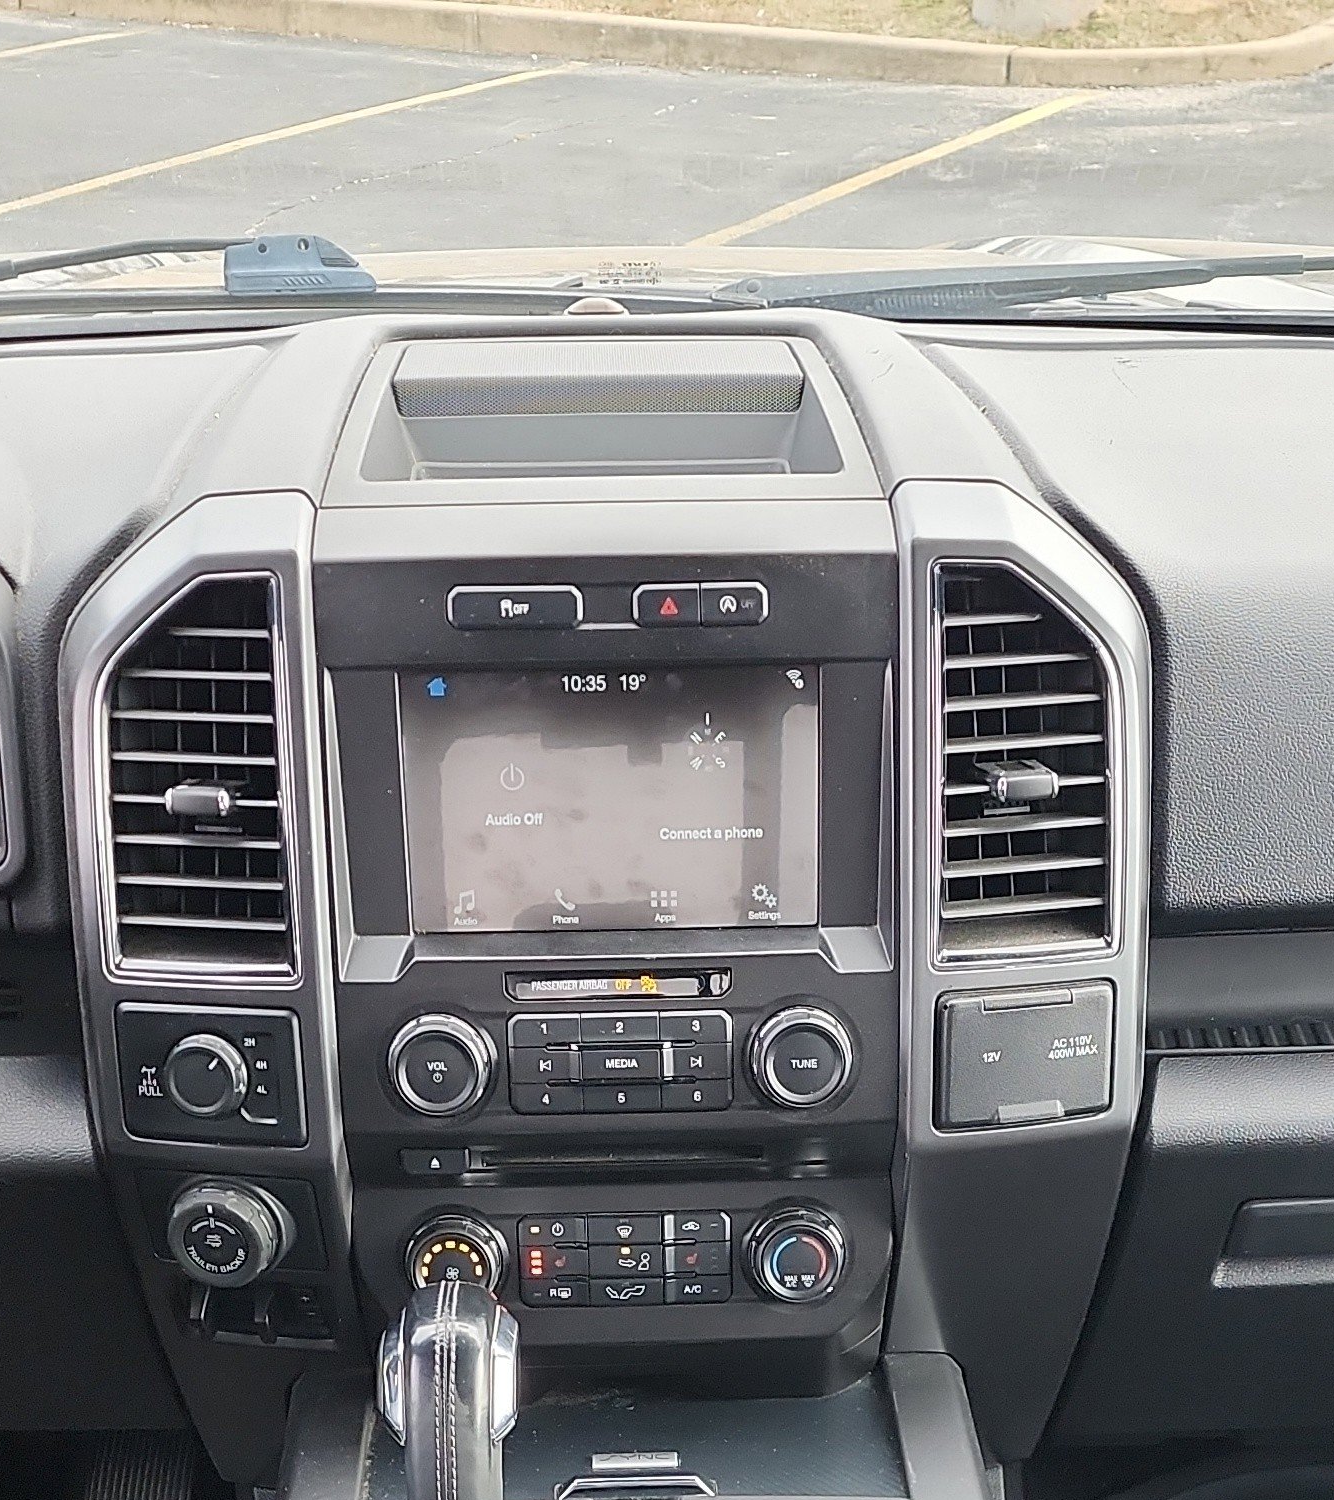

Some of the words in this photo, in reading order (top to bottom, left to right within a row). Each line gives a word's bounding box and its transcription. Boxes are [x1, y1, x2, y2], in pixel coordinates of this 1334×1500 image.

[561, 675, 607, 693] 10:35
[485, 813, 521, 827] Audio
[523, 812, 544, 827] Off
[659, 827, 711, 841] Connect
[714, 830, 721, 840] a
[724, 826, 764, 843] phone
[552, 914, 579, 925] Phone
[654, 912, 676, 925] Apps
[748, 909, 782, 922] Settings
[531, 980, 578, 991] PASSENGER
[579, 980, 608, 991] AIRBAG
[615, 980, 632, 991] OFF
[540, 1023, 548, 1034] 1
[615, 1022, 624, 1033] 2
[692, 1020, 701, 1032] 3
[1053, 1037, 1068, 1049] AC
[1069, 1034, 1093, 1047] 110V
[982, 1051, 1001, 1063] 12V
[1048, 1049, 1075, 1060] 400W
[1075, 1044, 1098, 1056] MAX
[255, 1060, 267, 1070] 4H
[427, 1061, 448, 1072] VOL
[605, 1058, 638, 1069] MEDIA
[790, 1058, 818, 1070] TUNE
[138, 1084, 163, 1097] PULL
[256, 1085, 267, 1095] 4L
[693, 1090, 702, 1102] 6
[541, 1093, 550, 1105] 4
[617, 1092, 626, 1104] 5
[186, 1245, 218, 1273] TRAILER
[219, 1247, 247, 1274] BACKUP
[683, 1284, 702, 1295] A/C
[599, 1453, 670, 1461] SYNC
